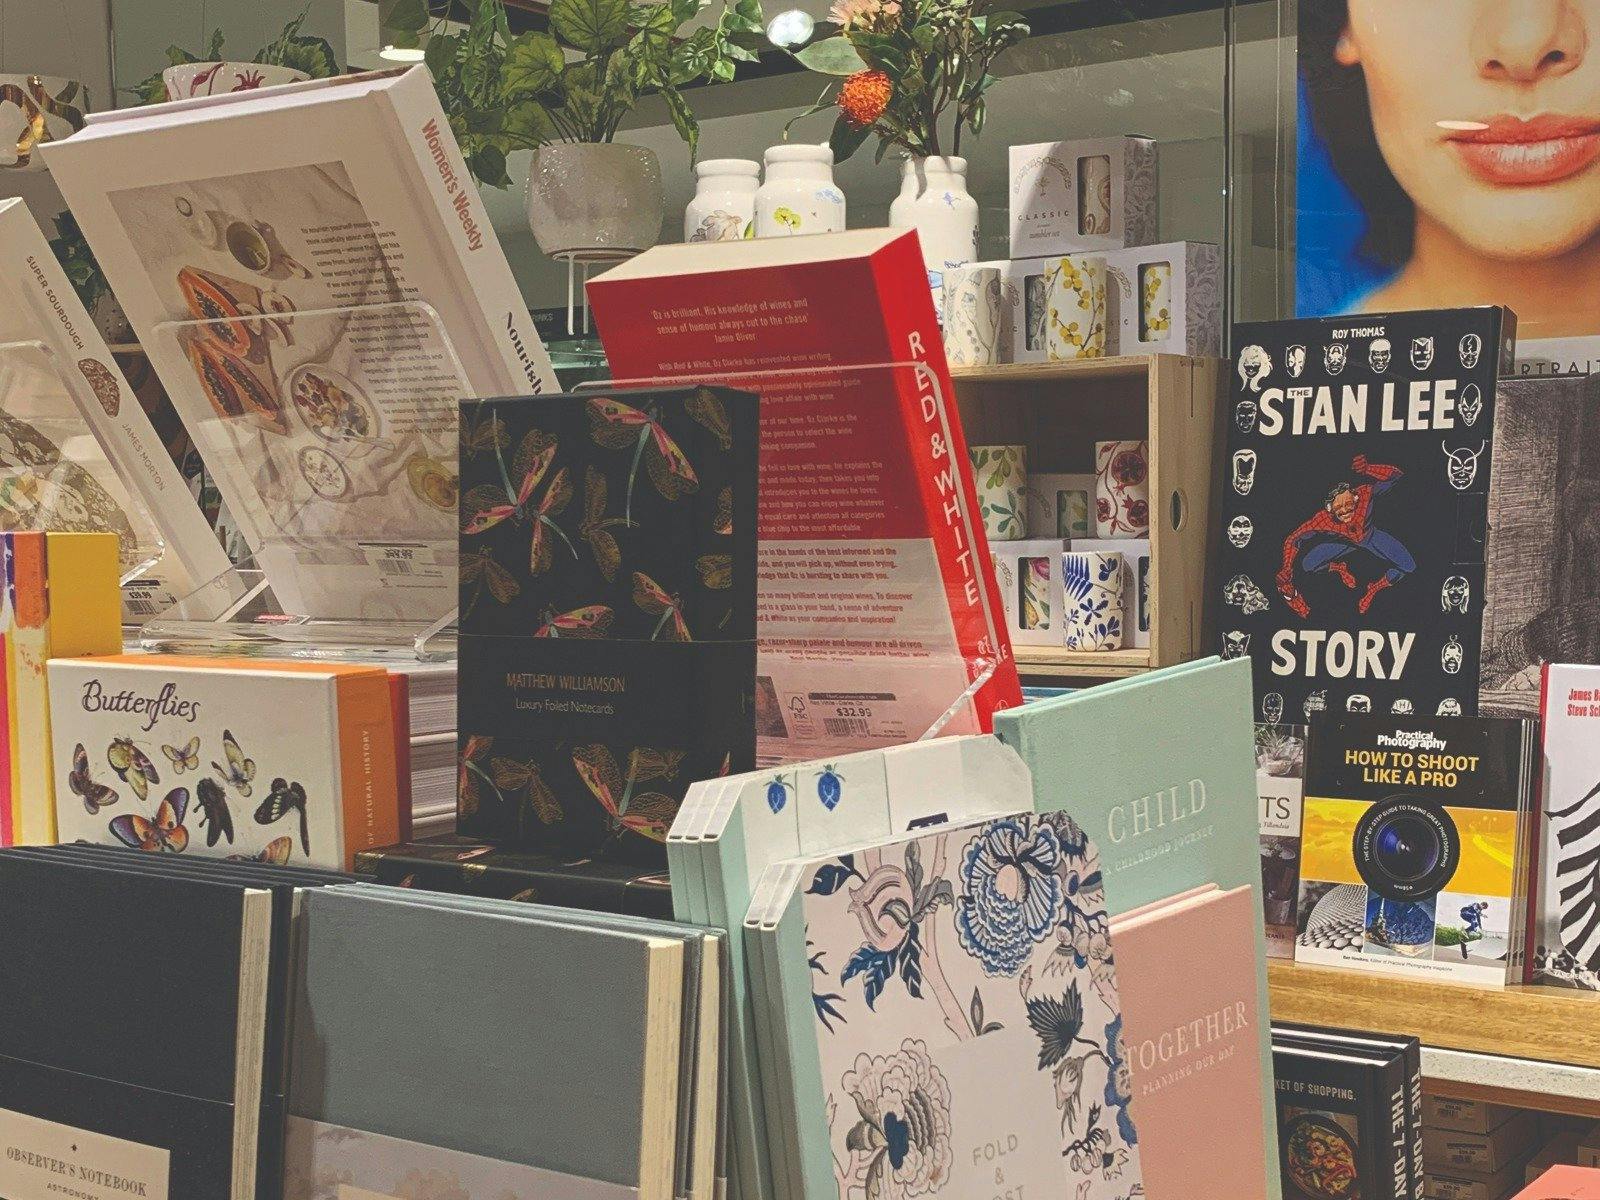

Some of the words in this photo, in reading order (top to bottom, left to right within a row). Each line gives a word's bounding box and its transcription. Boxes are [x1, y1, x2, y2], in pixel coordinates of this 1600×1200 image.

[421, 118, 458, 194] Women's
[453, 189, 483, 252] Weekly
[1018, 210, 1069, 221] CLASSIC
[26, 255, 48, 287] SUPER
[47, 288, 85, 351] SOURDOUGH
[704, 306, 717, 316] His
[718, 302, 758, 314] knowledge
[760, 300, 768, 310] of
[770, 300, 792, 310] wines
[794, 297, 808, 307] and
[656, 324, 679, 335] sense
[680, 323, 688, 333] of
[719, 319, 745, 330] always
[760, 316, 769, 326] to
[770, 315, 782, 325] the
[1332, 328, 1348, 340] ROY
[1350, 326, 1385, 338] THOMAS
[908, 331, 937, 423] RED
[1290, 389, 1310, 397] THE
[1258, 383, 1369, 437] STAN
[1381, 379, 1457, 432] LEE
[121, 423, 145, 453] JAMES
[141, 451, 166, 492] MORTON
[930, 432, 947, 460] &
[934, 464, 979, 607] WHITE
[808, 560, 822, 568] pick
[817, 592, 829, 600] and
[885, 592, 913, 600] discover
[768, 638, 808, 648] razor-sharp
[808, 638, 831, 648] palate
[832, 638, 845, 647] and
[845, 639, 873, 648] humour
[875, 640, 887, 648] are
[1270, 629, 1416, 681] STORY
[506, 673, 557, 689] MATTHEW
[560, 675, 625, 692] WILLIAMSON
[1568, 688, 1592, 701] James
[81, 679, 201, 731] Butterflies
[515, 698, 543, 713] Luxury
[545, 699, 568, 712] Foiled
[571, 701, 614, 715] Notecards
[1567, 704, 1588, 716] Steve
[1377, 734, 1447, 750] Photography
[1395, 730, 1434, 741] Practical
[1345, 749, 1388, 766] HOW
[1390, 752, 1414, 768] TO
[1417, 755, 1479, 772] SHOOT
[1363, 768, 1402, 784] LIKE
[1404, 770, 1417, 785] A
[1420, 771, 1458, 788] PRO
[1108, 778, 1206, 843] CHILD
[1259, 796, 1291, 820] TS
[1382, 806, 1398, 816] GUIDE
[1407, 805, 1427, 815] TAKING
[1426, 812, 1442, 827] GREAT
[1438, 825, 1450, 868] PHOTOGRAPHS
[1127, 1001, 1248, 1076] TOGETHER
[1293, 1081, 1304, 1092] OF
[1308, 1083, 1357, 1101] SHOPPING.
[1411, 1067, 1421, 1116] THE
[1391, 1084, 1404, 1134] THE
[972, 1133, 1018, 1167] FOLD
[1412, 1115, 1423, 1179] 7-DAY
[6, 1145, 76, 1179] OBSERVER'S
[79, 1165, 147, 1198] NOTEBOOK
[995, 1166, 1005, 1186] &
[1393, 1132, 1407, 1198] 7-DAY
